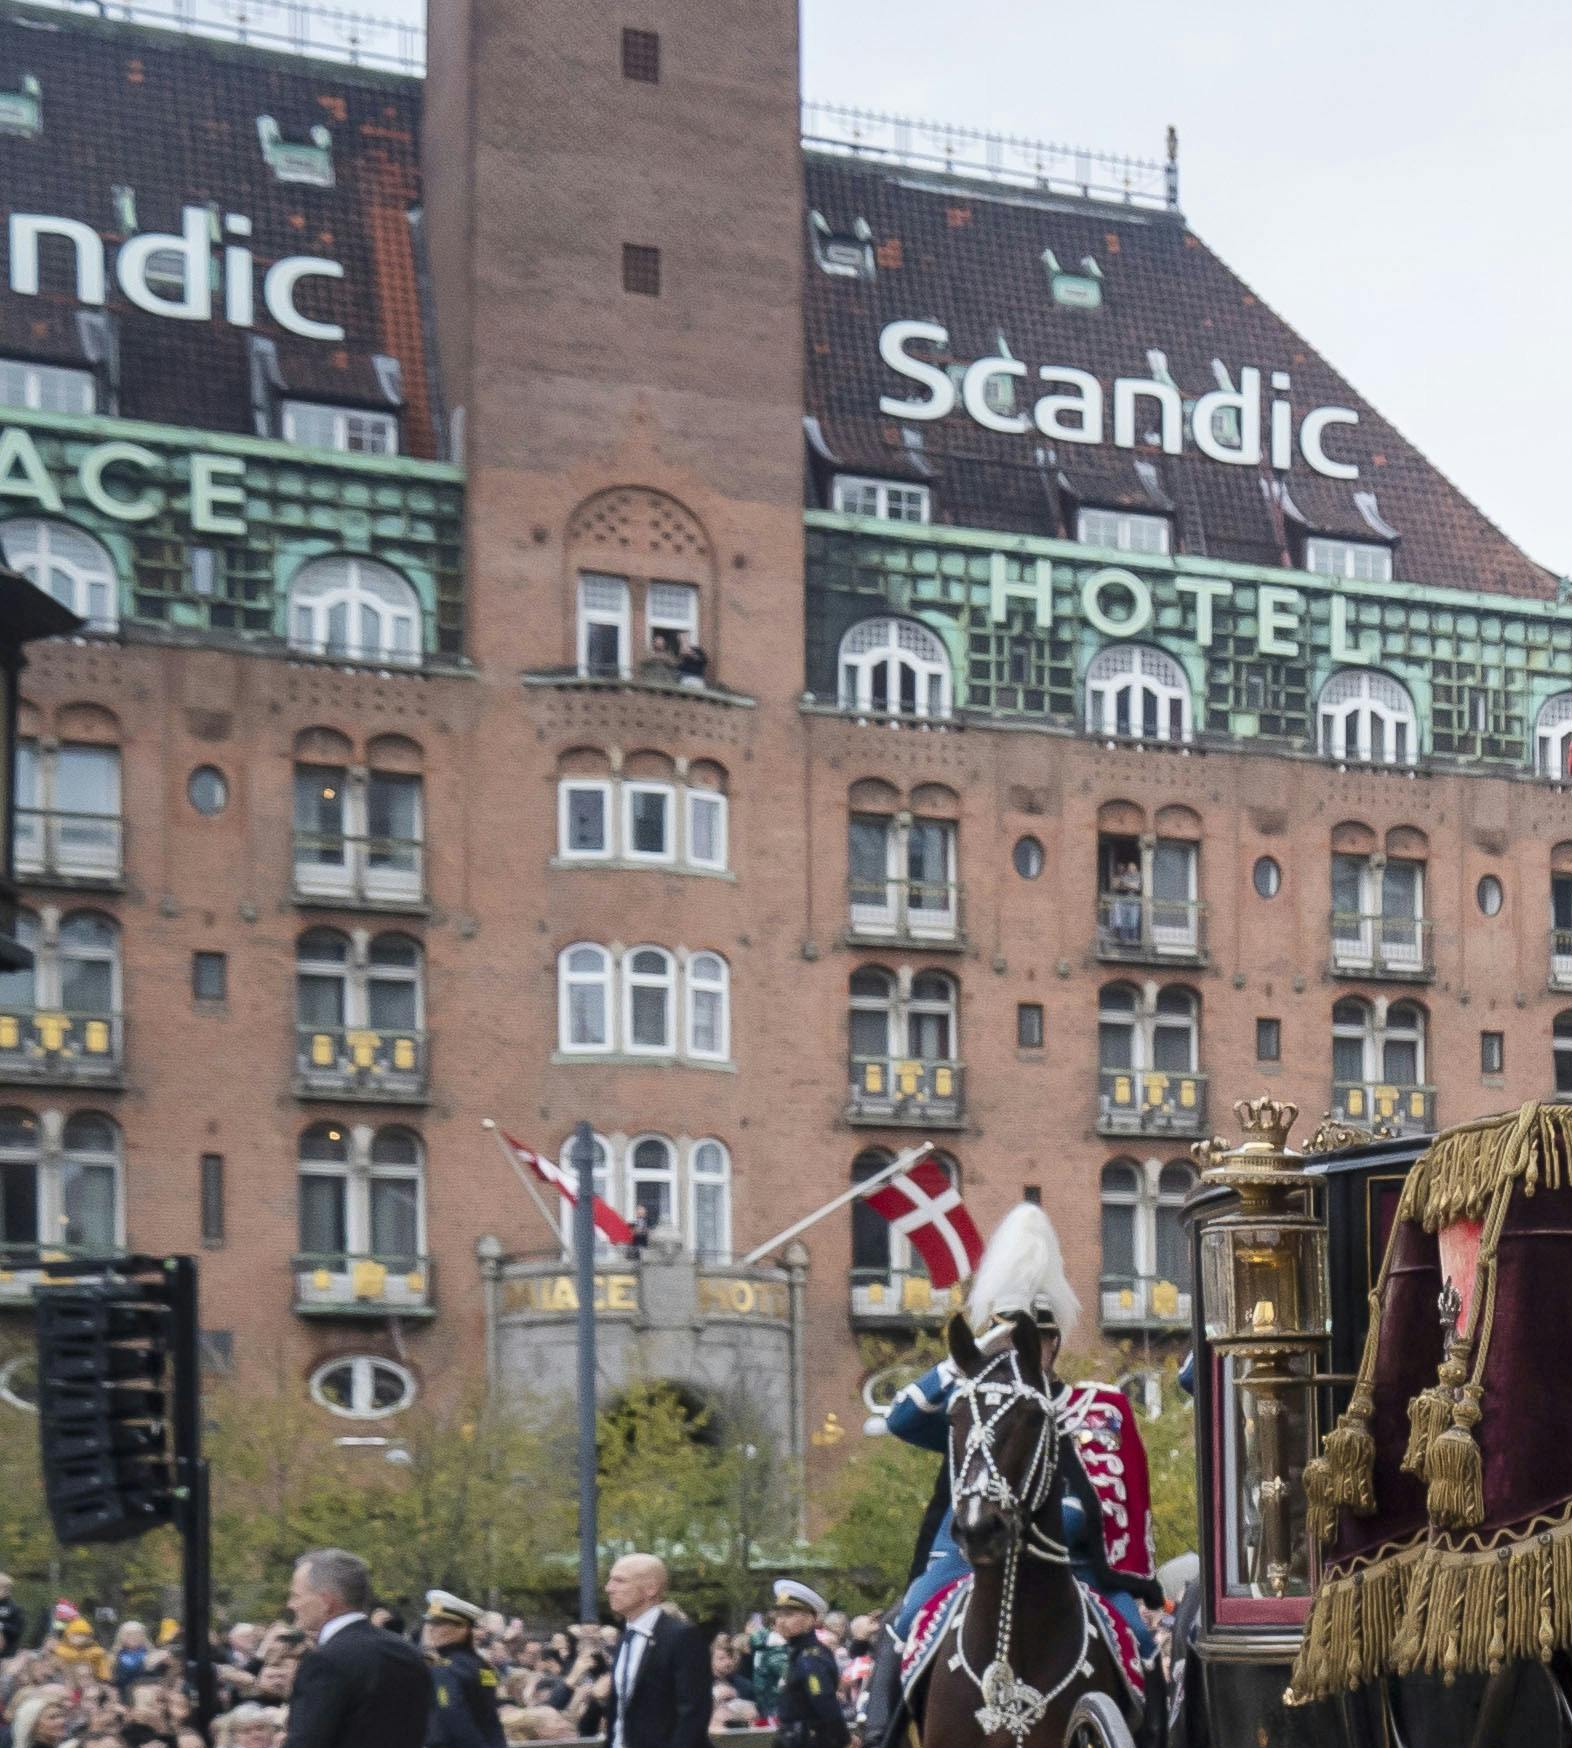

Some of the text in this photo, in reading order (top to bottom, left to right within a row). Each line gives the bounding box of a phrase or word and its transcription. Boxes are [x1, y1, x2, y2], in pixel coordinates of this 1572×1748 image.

[8, 205, 345, 341] ndic
[879, 319, 1361, 480] Scandic
[0, 426, 248, 536] ACE
[989, 552, 1370, 665] HOTEL
[503, 1274, 639, 1312] LAE
